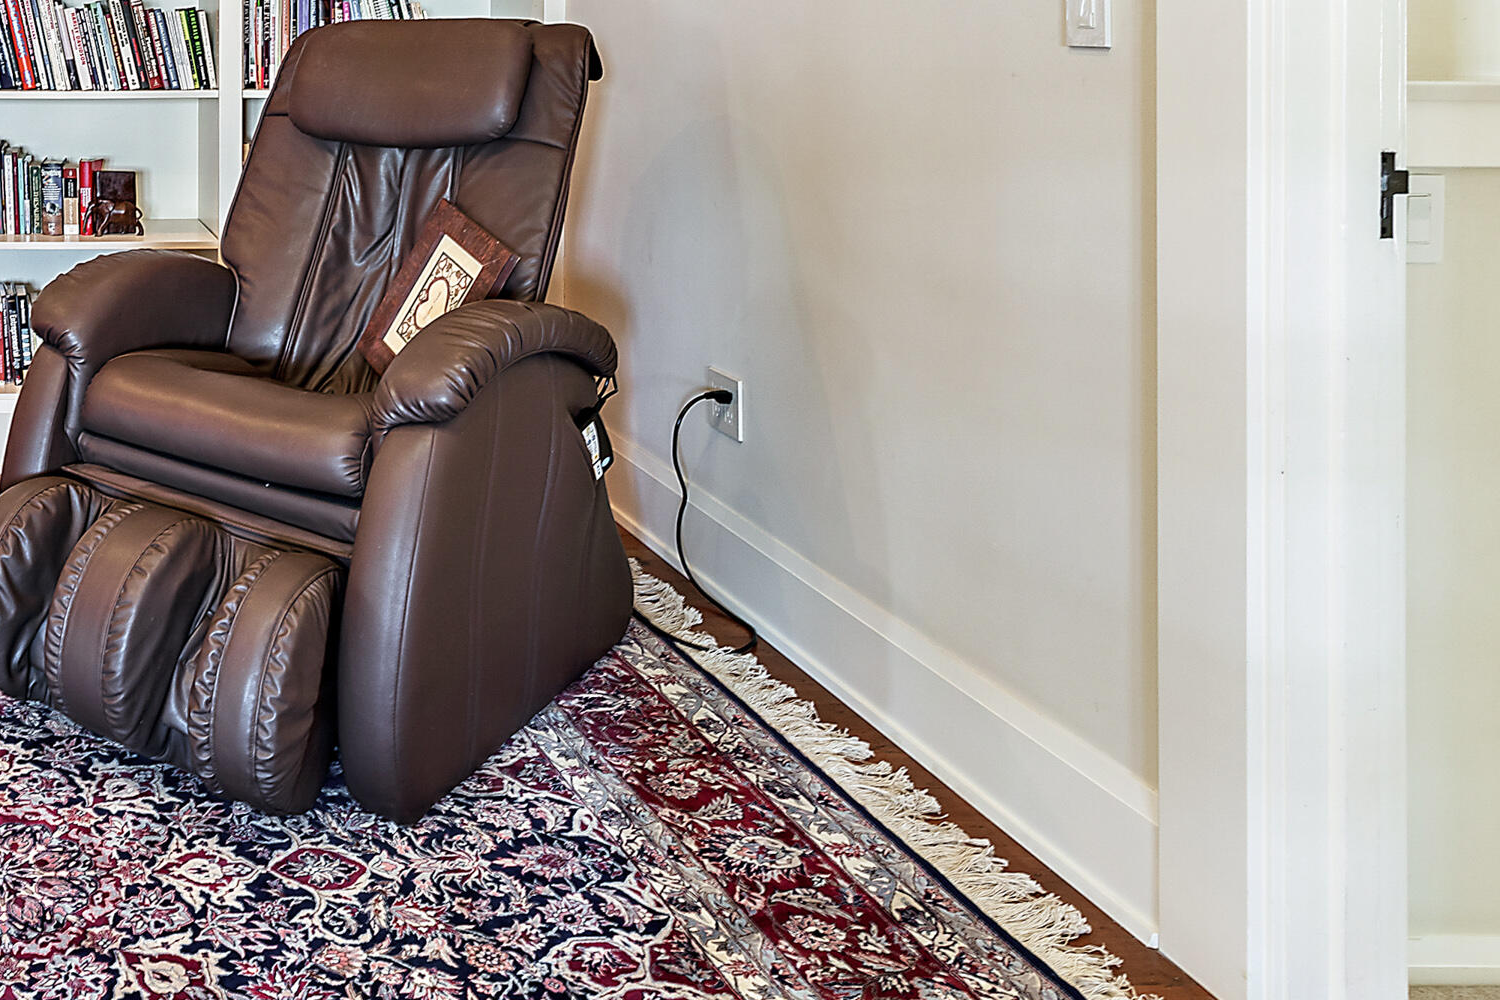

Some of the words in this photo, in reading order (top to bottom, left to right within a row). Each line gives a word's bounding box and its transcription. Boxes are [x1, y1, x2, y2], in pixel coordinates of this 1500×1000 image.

[70, 12, 78, 35] HARLEY
[75, 35, 86, 65] DAVIDSON
[190, 13, 202, 40] EMERALD
[150, 59, 158, 77] Moon
